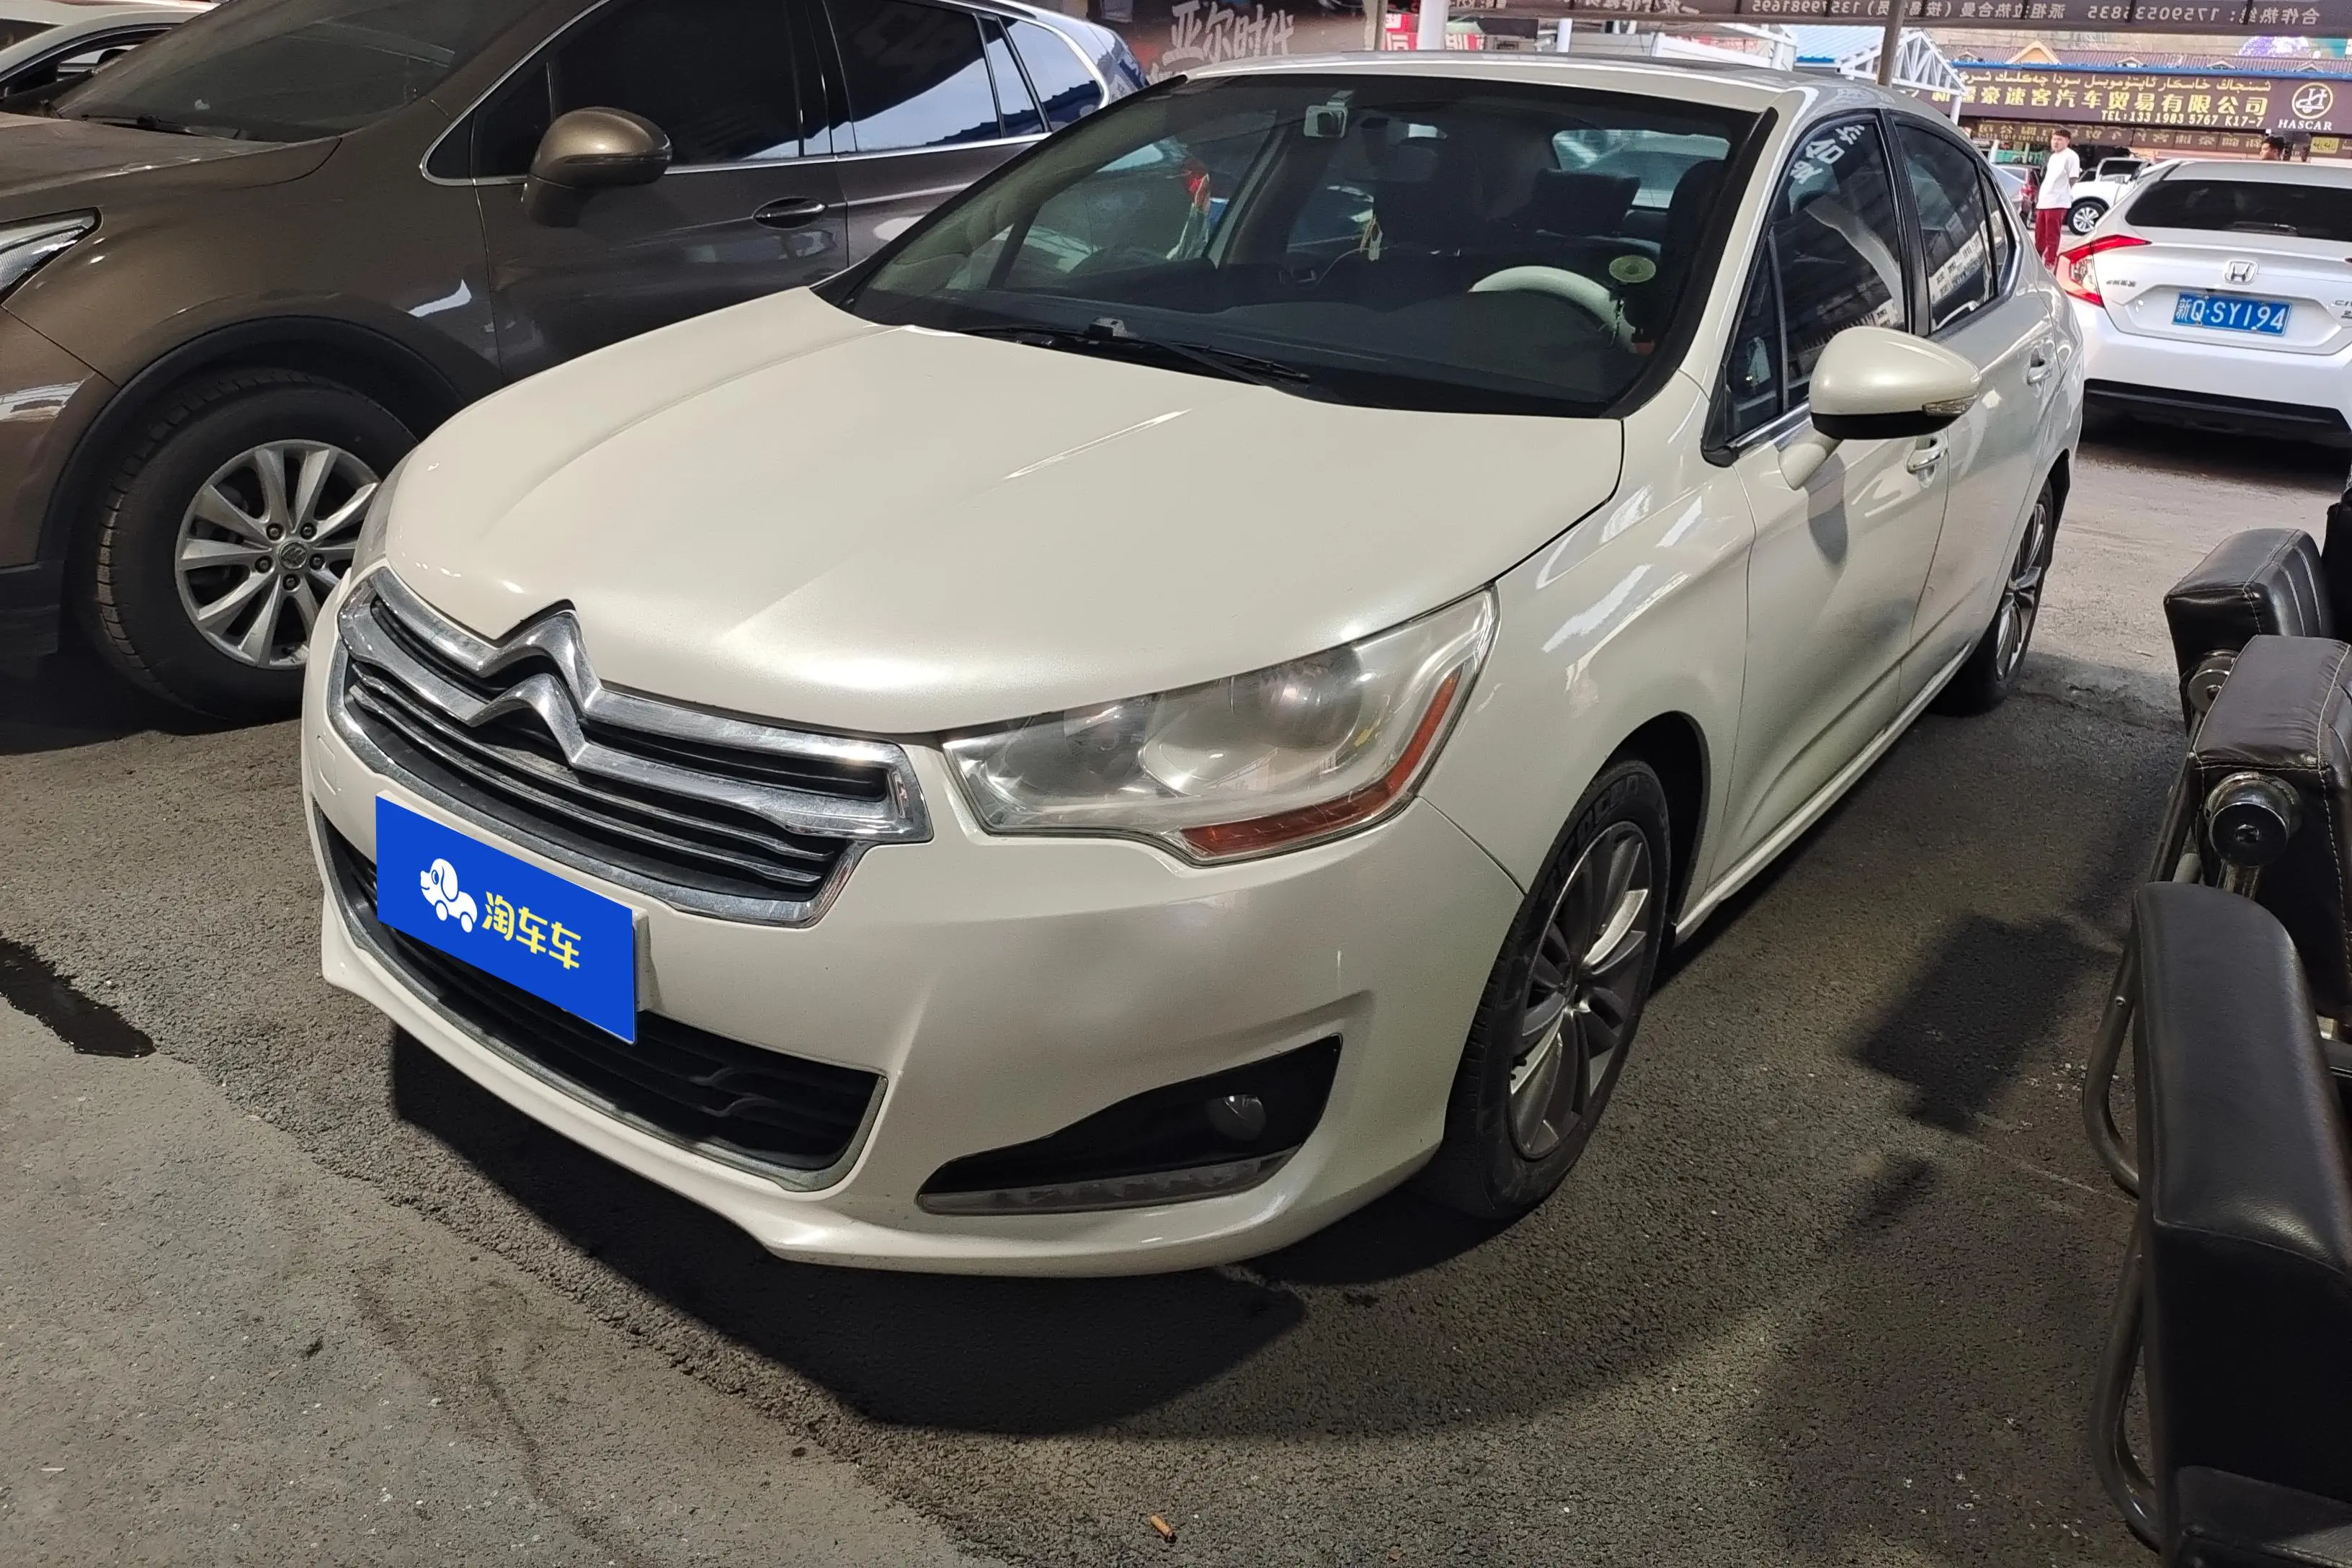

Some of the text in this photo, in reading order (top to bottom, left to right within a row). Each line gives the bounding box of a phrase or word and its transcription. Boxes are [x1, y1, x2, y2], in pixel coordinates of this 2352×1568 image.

[1162, 0, 1294, 63] 亚尔时代
[2155, 112, 2184, 125] 1983
[2188, 114, 2219, 126] 5767
[2278, 119, 2333, 130] HASCAR
